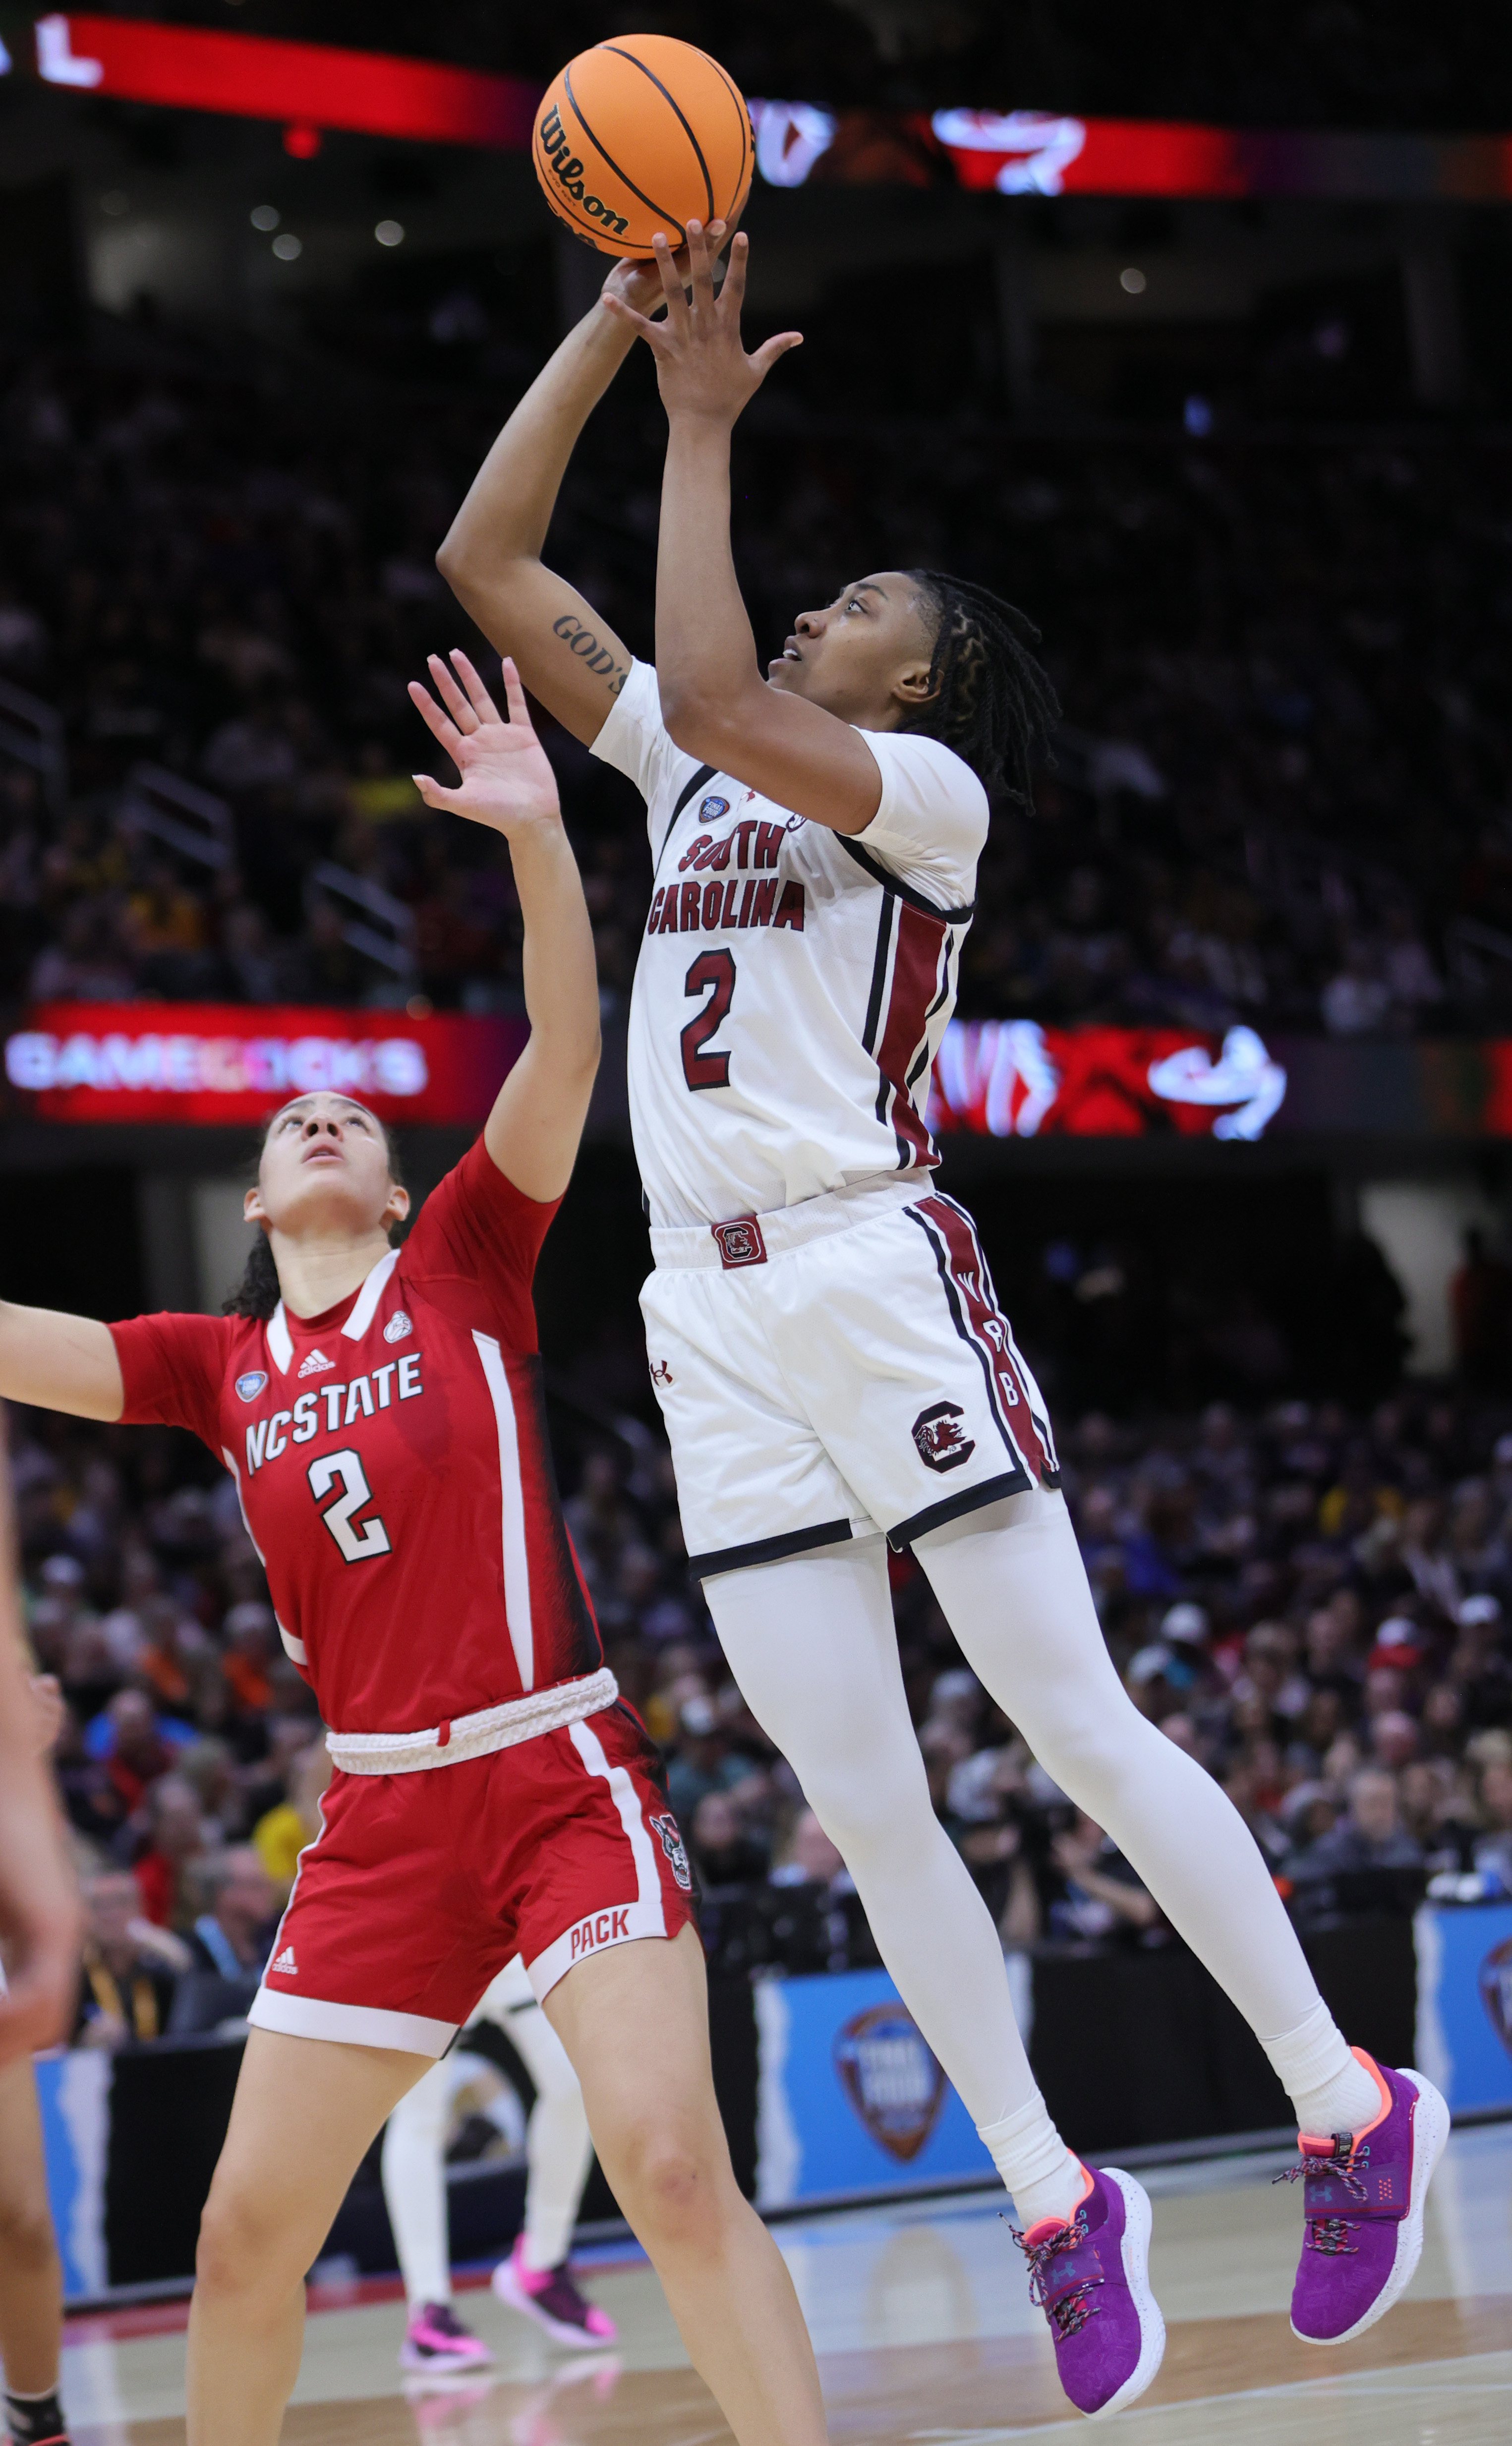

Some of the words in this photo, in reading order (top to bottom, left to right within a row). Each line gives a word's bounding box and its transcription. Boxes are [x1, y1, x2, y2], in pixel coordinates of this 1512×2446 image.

[540, 102, 629, 235] Wilson
[701, 806, 719, 817] FOUR
[707, 801, 723, 812] FINAL
[678, 820, 787, 872] SOUTH
[647, 877, 805, 935] CAROLINA
[680, 947, 736, 1092] 2
[297, 1361, 337, 1379] adidas
[306, 1447, 392, 1565] 2
[570, 1909, 630, 1960] PACK
